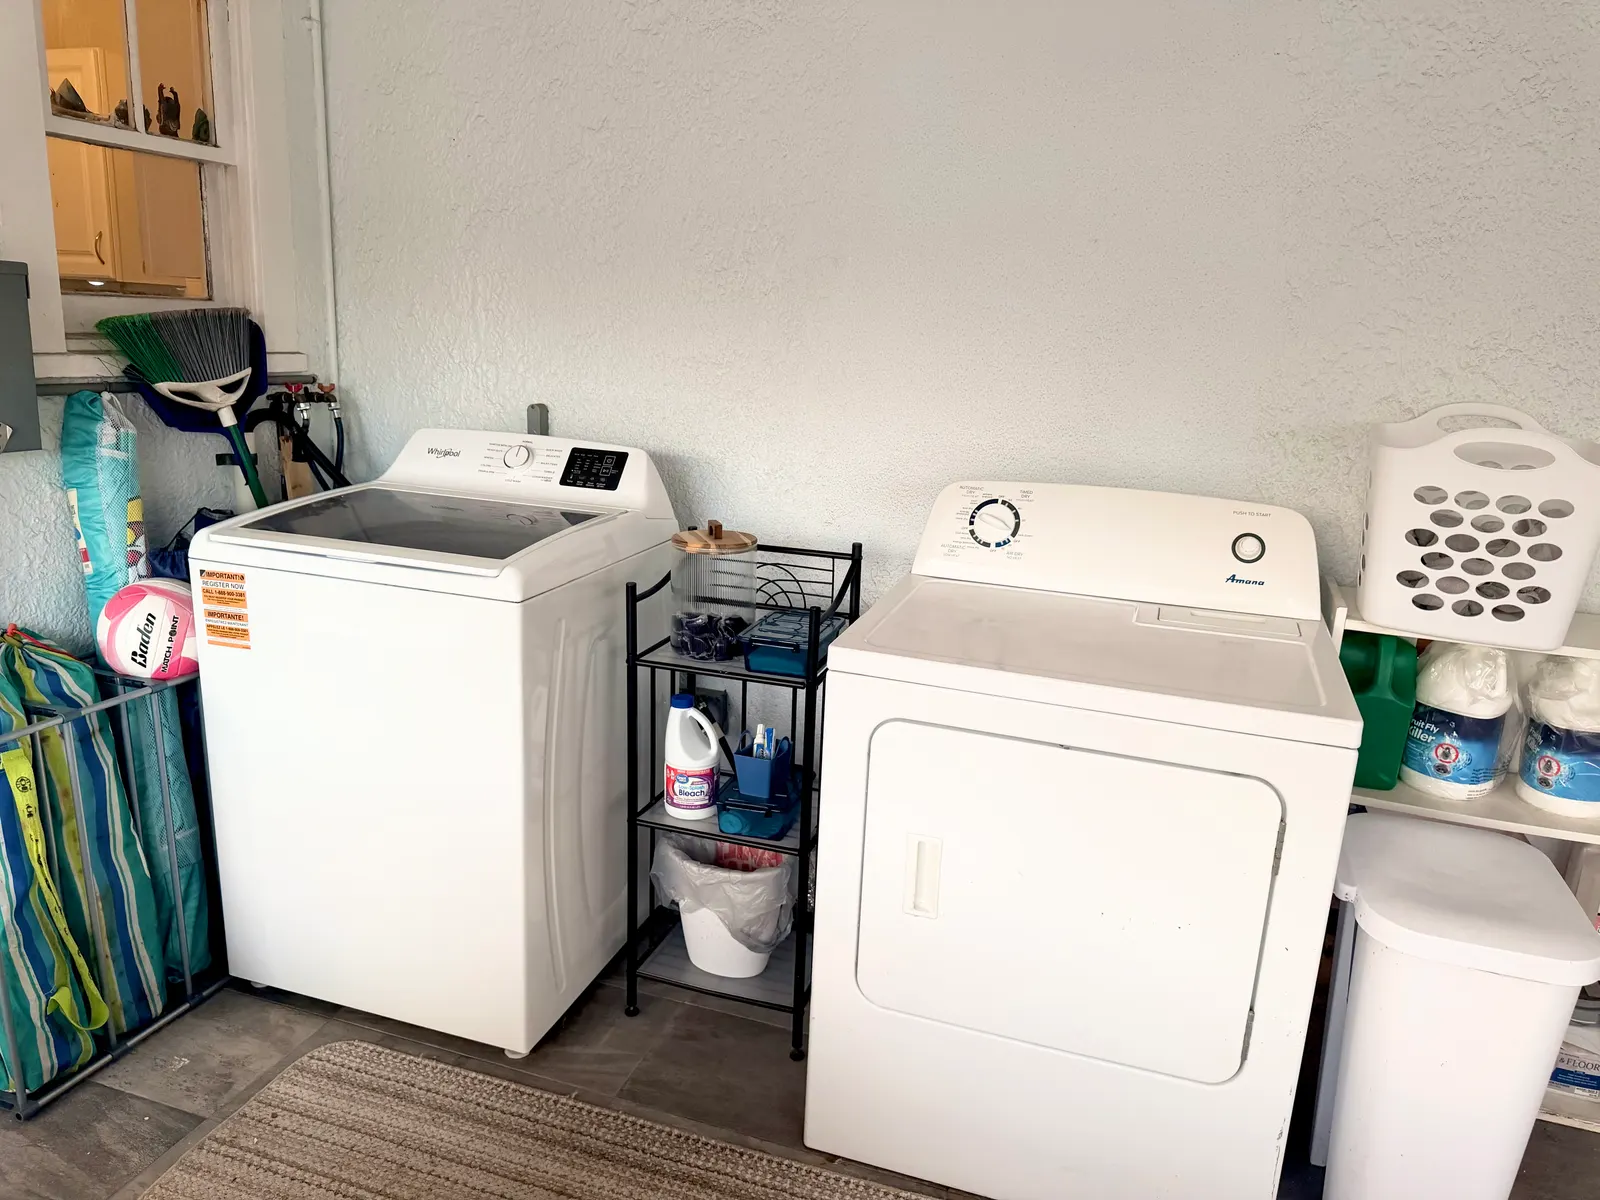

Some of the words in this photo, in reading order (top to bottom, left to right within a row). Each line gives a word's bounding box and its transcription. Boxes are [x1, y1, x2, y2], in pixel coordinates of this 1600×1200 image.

[427, 447, 461, 459] Whirlpool
[202, 580, 230, 588] REGISTER
[1225, 573, 1265, 586] Amana
[207, 611, 244, 620] IMPORTANTE!
[130, 612, 157, 669] Baden
[161, 646, 173, 673] MATCH
[168, 615, 179, 643] POINT
[1411, 718, 1426, 729] ruit
[1425, 722, 1440, 733] Fly
[678, 788, 705, 797] Bleach
